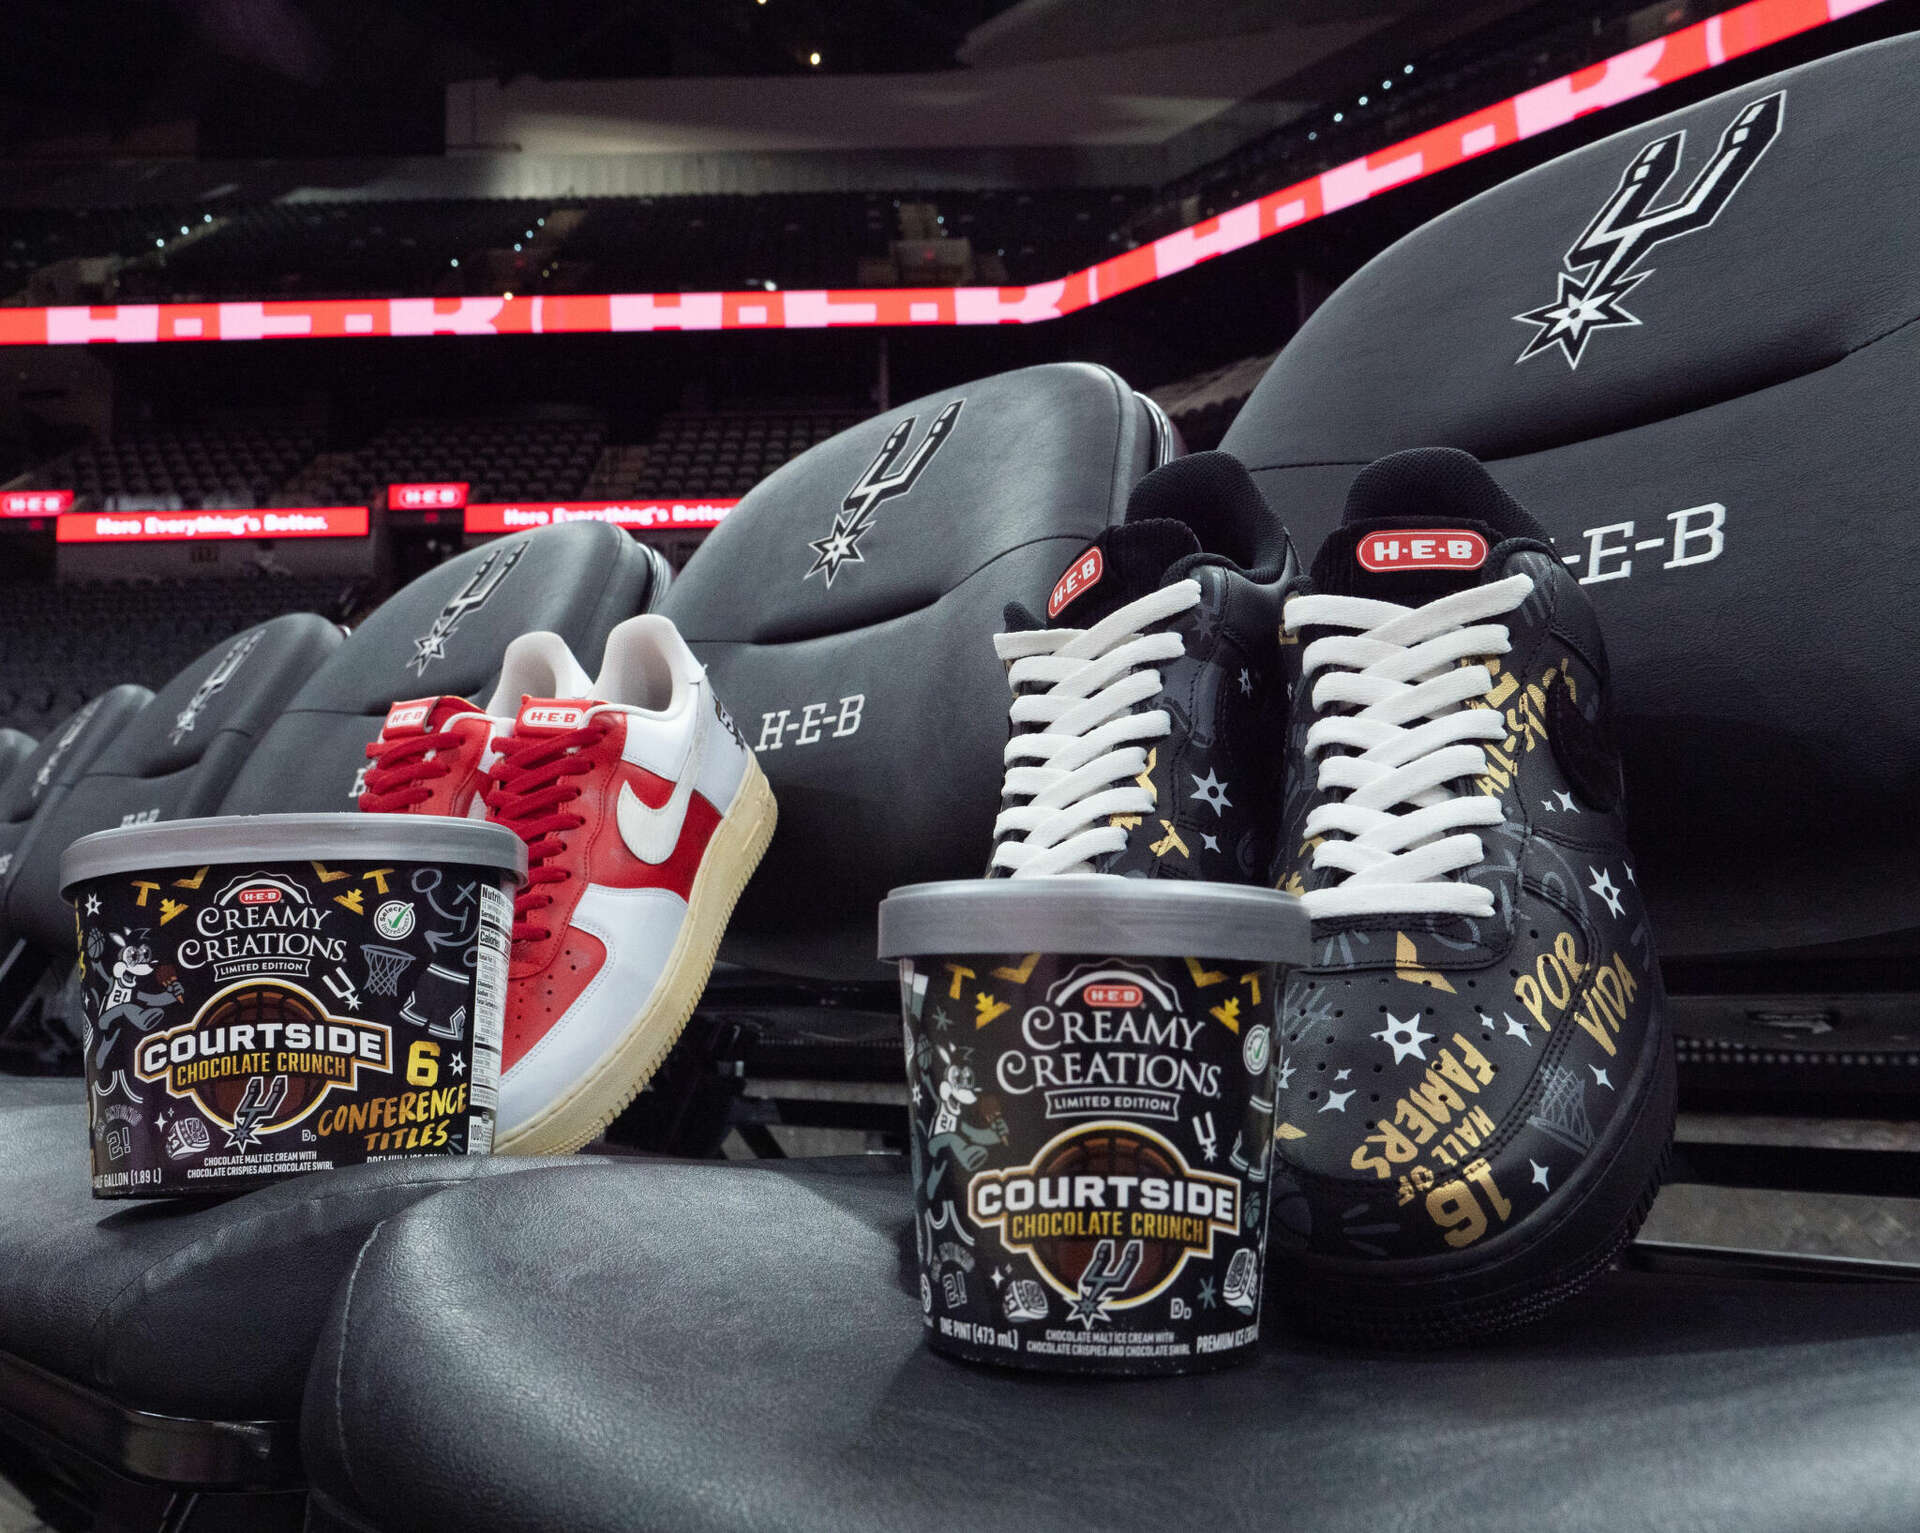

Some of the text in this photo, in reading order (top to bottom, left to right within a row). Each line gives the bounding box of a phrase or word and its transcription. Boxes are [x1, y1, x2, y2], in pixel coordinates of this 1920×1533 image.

[96, 517, 142, 535] Here
[144, 514, 261, 537] Everything's
[503, 508, 550, 526] Here
[1550, 502, 1726, 585] -E-B
[754, 693, 866, 752] H-E-B
[196, 904, 333, 937] CREAMY
[177, 932, 348, 970] CREATIONS
[220, 961, 303, 976] LIMITED EDITION
[1514, 932, 1590, 1032] POR
[1575, 952, 1639, 1057] VIDA
[1021, 1005, 1206, 1052] CREAMY
[143, 1022, 383, 1072] COURTSIDE
[406, 1040, 441, 1087] 6
[176, 1051, 347, 1087] CHOCOLATE CRUNCH
[996, 1050, 1222, 1097] CREATIONS
[318, 1082, 468, 1136] CONFERENCE
[1054, 1096, 1171, 1111] LIMITED EDITION
[1351, 1032, 1497, 1179] FAMERS
[364, 1119, 450, 1151] TITLES
[187, 1161, 334, 1179] CHOCOLATE CRISPIES AND CHOCOLATE SWIRL
[204, 1151, 317, 1166] CHOCOLATE MALT ICE CREAM WITH
[1398, 1105, 1497, 1206] HALL OF
[104, 1171, 129, 1187] GALLON
[131, 1168, 151, 1186] (1.89
[153, 1167, 162, 1184] L)
[976, 1175, 1234, 1221] COURTSIDE
[1426, 1157, 1512, 1248] 16
[1012, 1210, 1205, 1243] CHOCOLATE CRUNCH
[940, 1316, 953, 1337] ONE
[953, 1319, 972, 1341] PINT
[972, 1322, 996, 1345] (473
[997, 1328, 1019, 1351] mL)
[1026, 1340, 1191, 1357] CHOCOLATE CRISPIES AND CHOCOLATE SWIRL
[1045, 1329, 1176, 1344] CHOCOLATE MALT ICE CREAM WITH
[1196, 1331, 1234, 1354] PREMIUM
[1235, 1328, 1245, 1346] ICE
